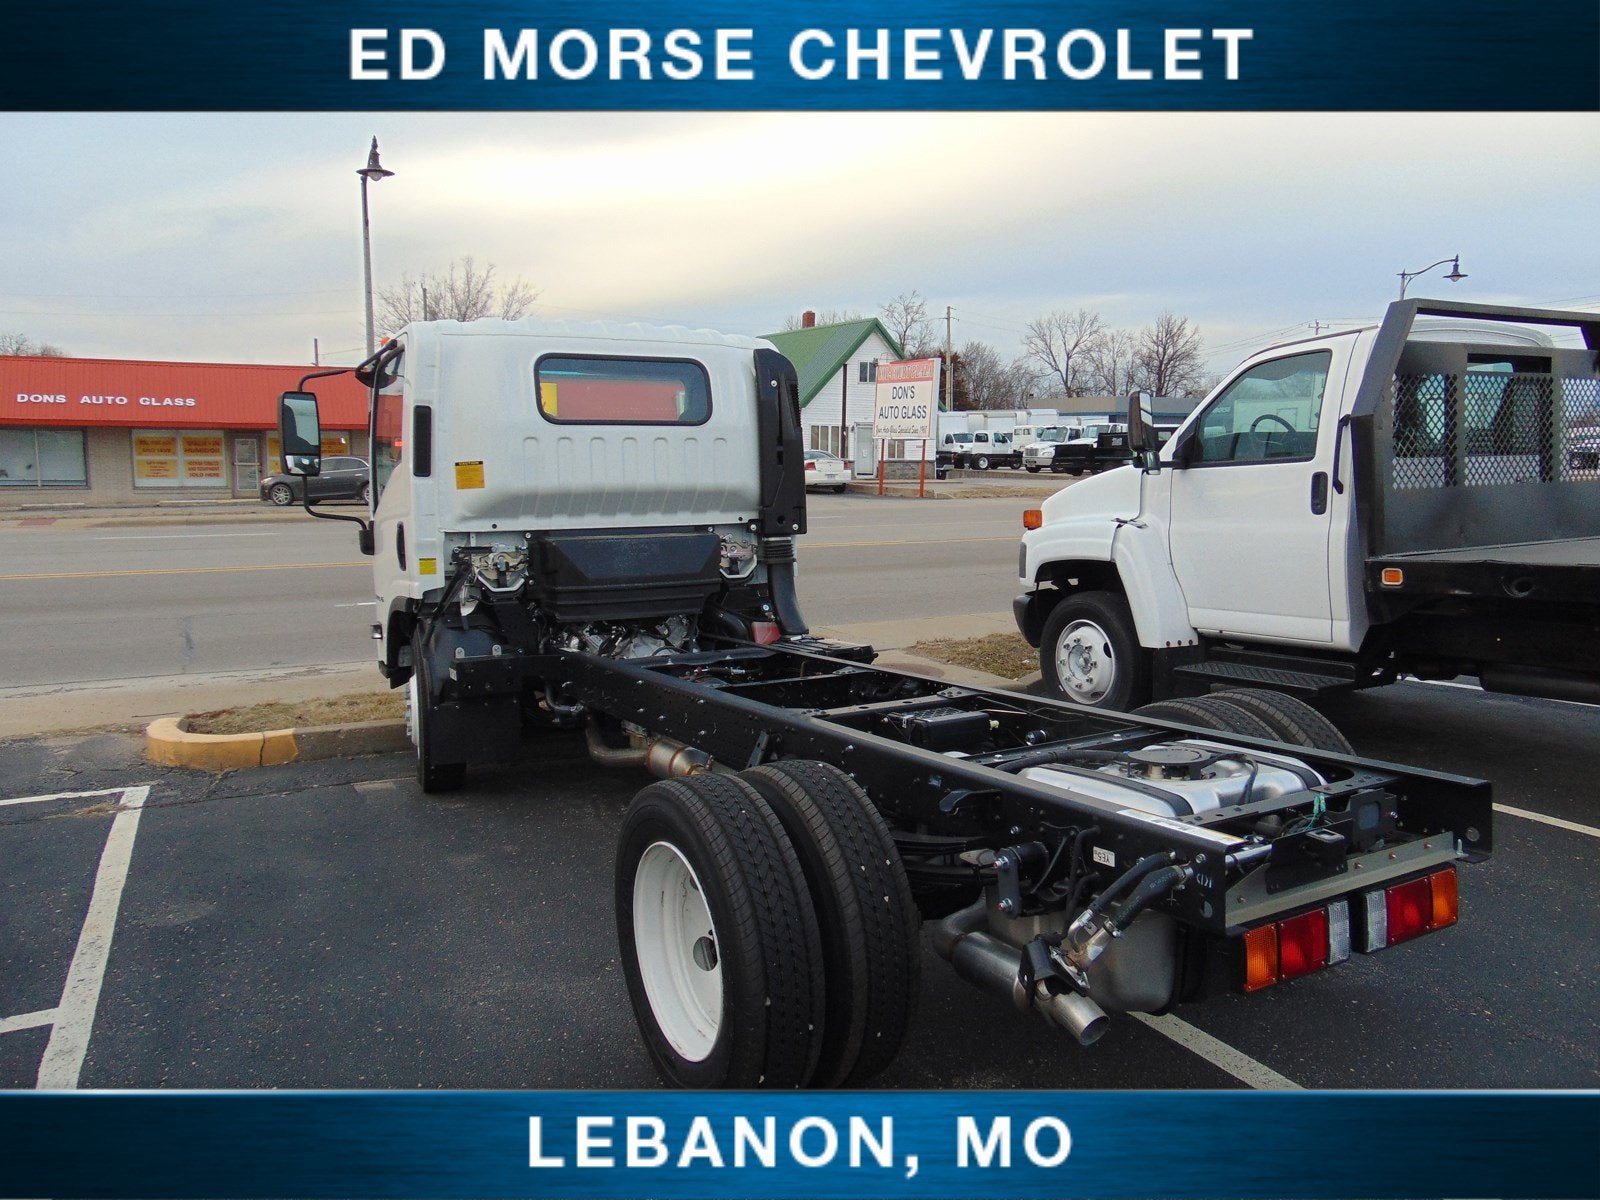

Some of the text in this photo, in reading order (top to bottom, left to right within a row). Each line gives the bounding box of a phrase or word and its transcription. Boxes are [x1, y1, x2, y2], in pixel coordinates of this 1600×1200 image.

[892, 385, 915, 399] DON'S
[16, 393, 196, 407] DONS AUTO GLASS
[879, 405, 927, 419] AUTO GLASS
